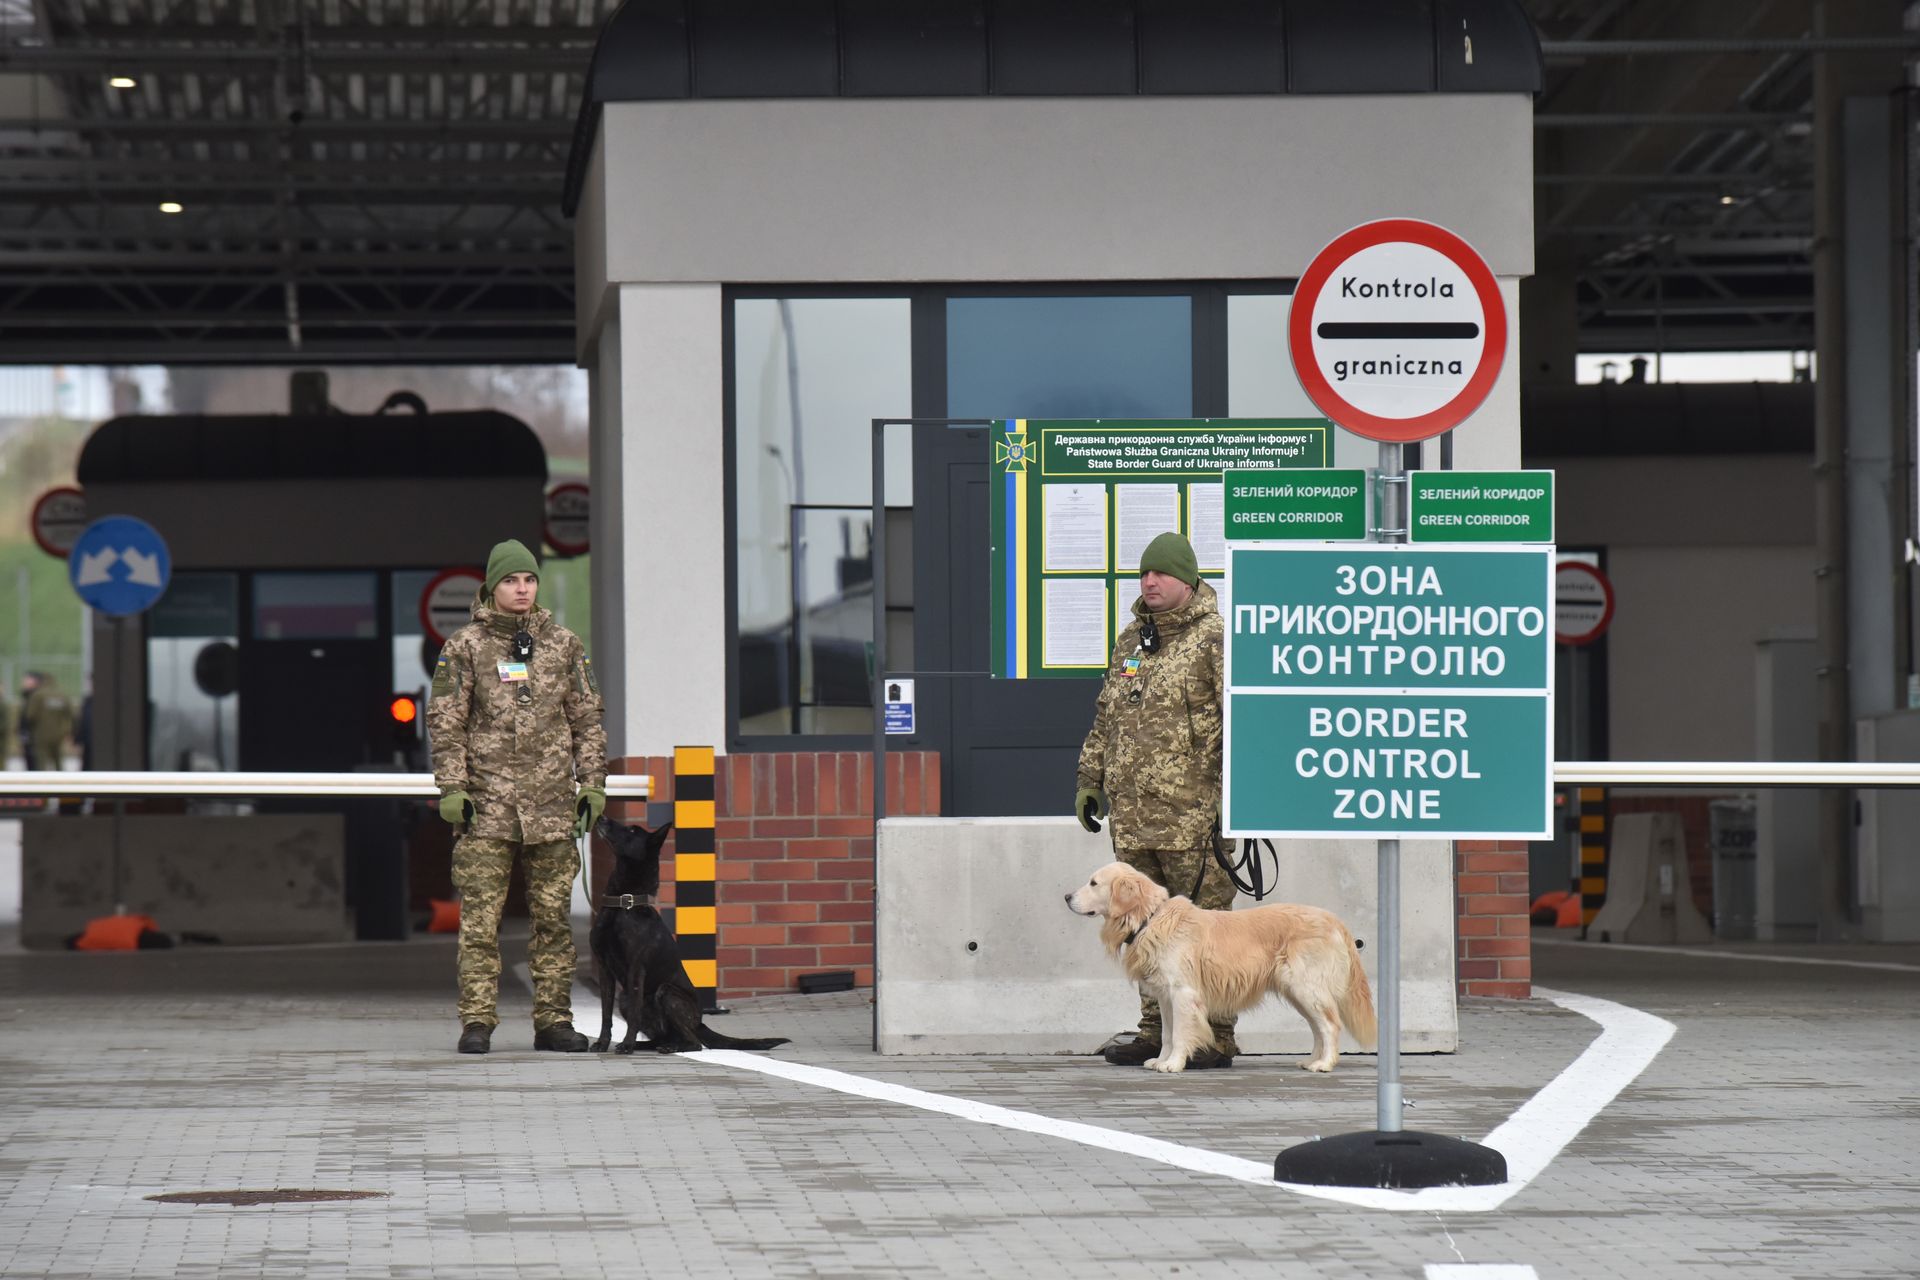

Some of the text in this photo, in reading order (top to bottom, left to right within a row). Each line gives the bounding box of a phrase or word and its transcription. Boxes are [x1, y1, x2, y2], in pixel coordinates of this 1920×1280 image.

[1342, 277, 1454, 298] Kontrola
[1334, 354, 1463, 381] graniczna
[1055, 434, 1106, 446] Державна
[1108, 436, 1175, 446] прикордонна
[1177, 434, 1215, 446] служба
[1217, 433, 1256, 445] України
[1258, 433, 1307, 445] інформує
[1066, 447, 1122, 456] Państwowa
[1124, 446, 1158, 456] Służba
[1160, 446, 1210, 456] Graniczna
[1212, 446, 1250, 457] Ukrainy
[1252, 446, 1299, 457] Informuje
[1088, 459, 1113, 469] State
[1115, 459, 1150, 469] Border
[1151, 459, 1182, 469] Guard
[1184, 459, 1195, 468] of
[1197, 459, 1235, 468] Ukraine
[1237, 458, 1275, 468] informs
[1232, 484, 1358, 499] ЗЕЛЕНИЙ КОРИДОР
[1419, 487, 1545, 501] ЗЕЛЕНИЙ КОРИДОР
[1232, 512, 1344, 523] GREEN CORRIDOR
[1419, 515, 1530, 525] GREEN CORRIDOR
[1335, 565, 1443, 595] ЗОНА
[1556, 582, 1596, 592] ontrola
[1235, 604, 1544, 641] ПРИКОРДОННОГО
[1272, 645, 1506, 676] КОНТРОЛЮ
[1310, 707, 1468, 738] BORDER
[1295, 748, 1481, 779] CONTROL
[1333, 789, 1441, 819] ZONE
